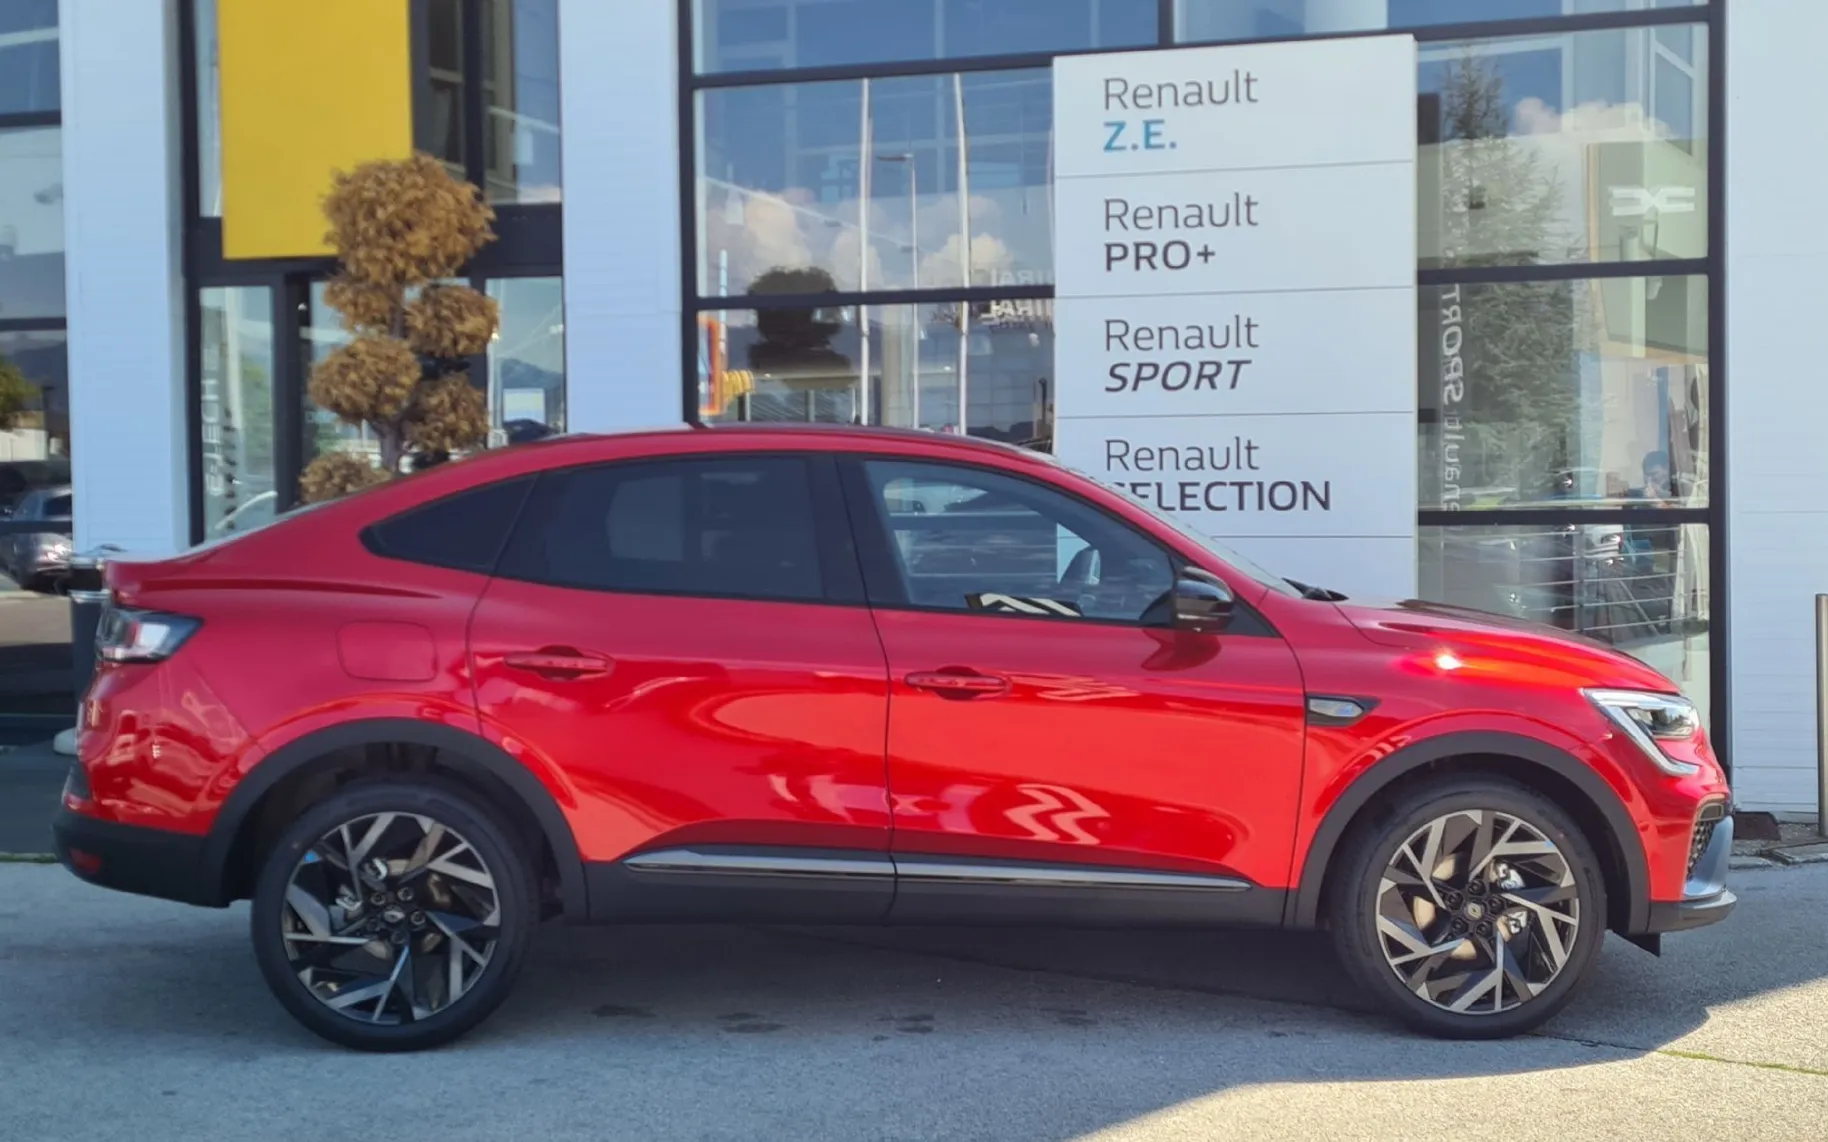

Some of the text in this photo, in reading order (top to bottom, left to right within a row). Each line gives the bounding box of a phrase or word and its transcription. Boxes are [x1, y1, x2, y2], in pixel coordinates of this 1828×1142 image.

[1103, 69, 1259, 110] Renault
[1103, 119, 1177, 152] Z.E.
[1103, 192, 1259, 232] Renault
[1104, 240, 1216, 272] PRO+
[1104, 314, 1260, 352] Renault
[1104, 359, 1252, 393] SPORT
[1105, 436, 1260, 472] Renault
[1113, 480, 1331, 512] ELECTION
